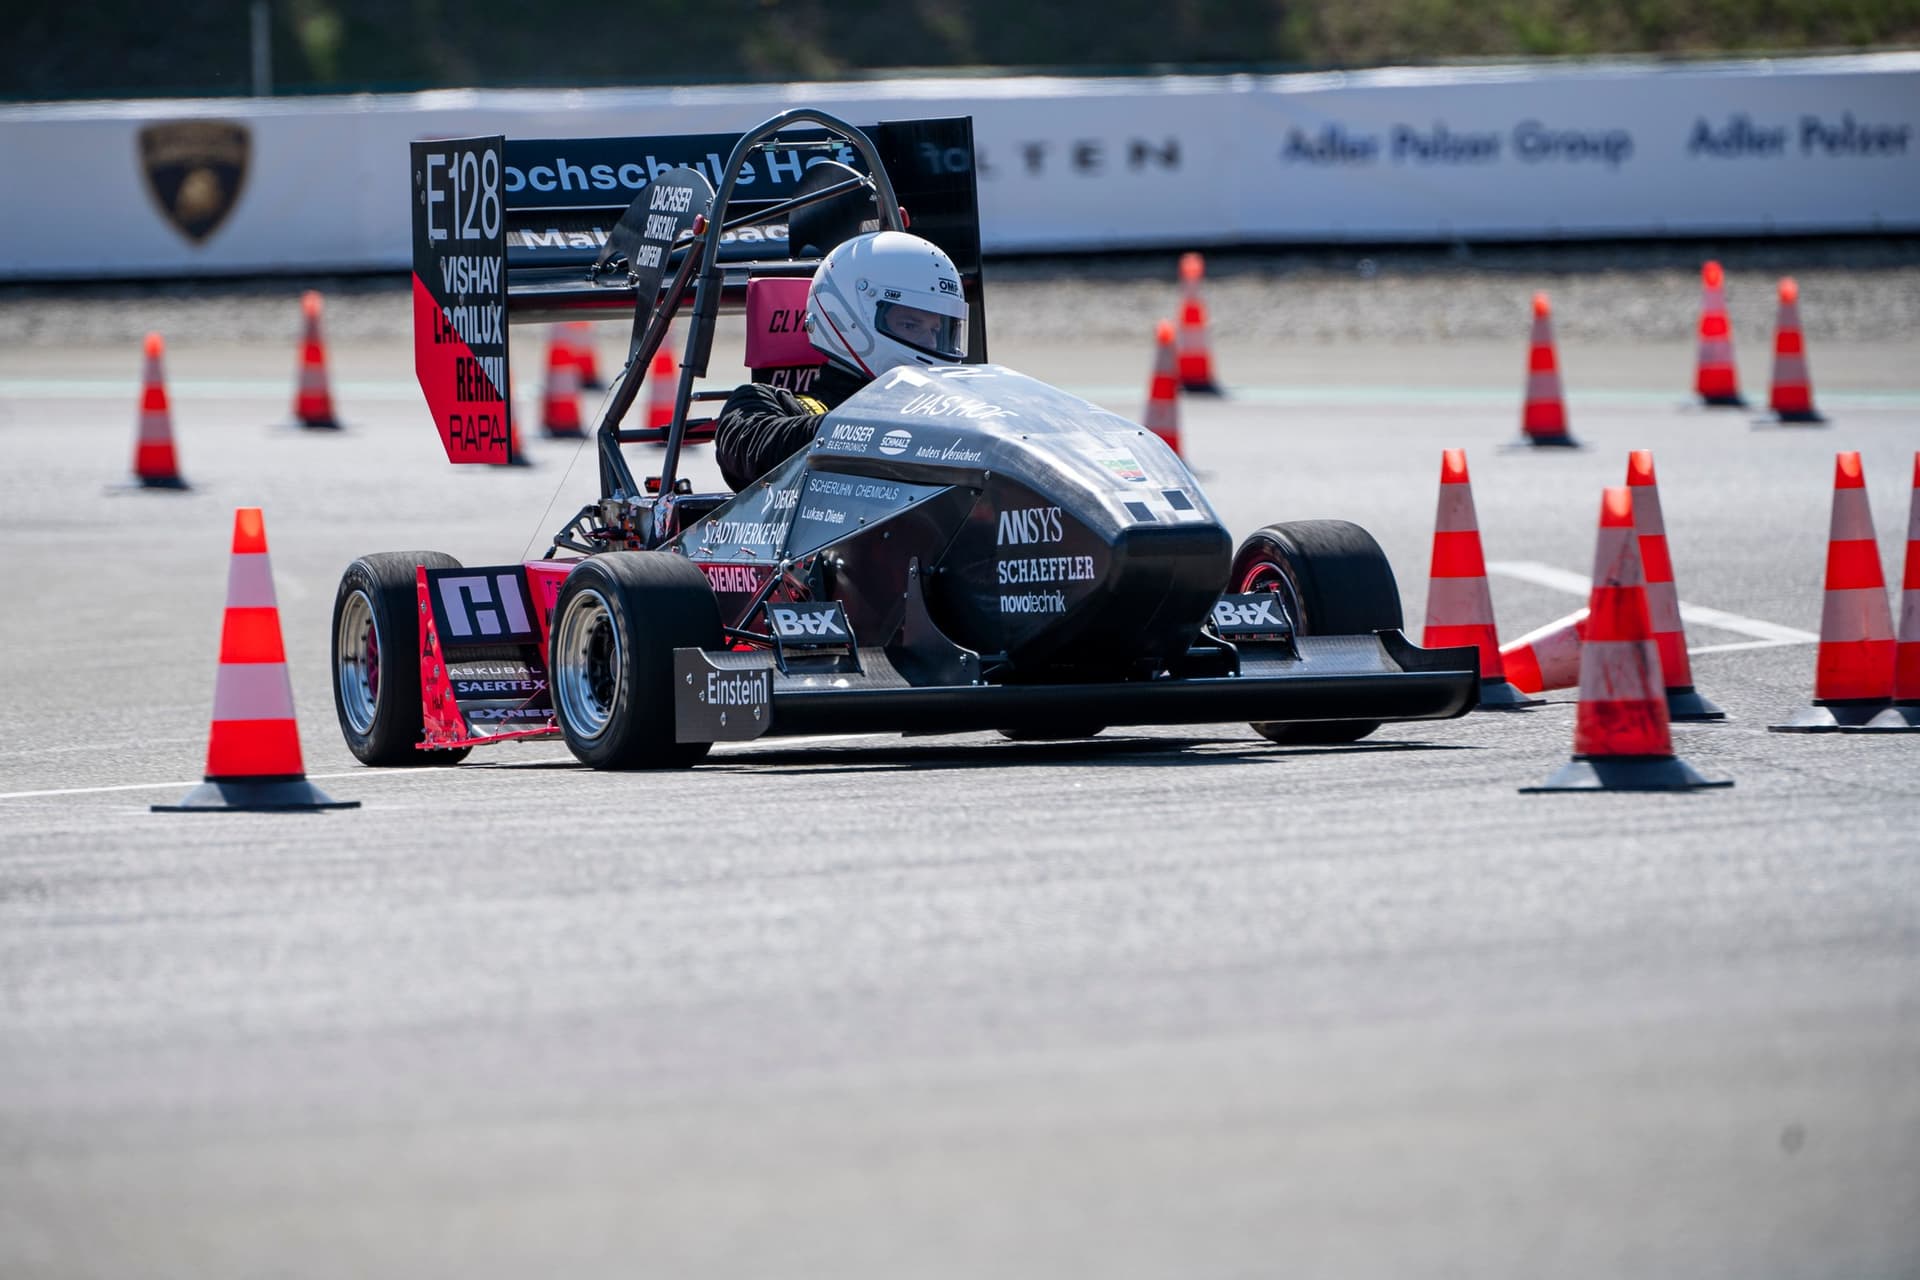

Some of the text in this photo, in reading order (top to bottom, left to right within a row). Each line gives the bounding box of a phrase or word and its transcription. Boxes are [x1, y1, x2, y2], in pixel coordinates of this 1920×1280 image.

[1281, 122, 1379, 165] Adler
[1511, 118, 1634, 171] Group
[975, 138, 1182, 179] LTEN
[427, 149, 500, 240] E128
[649, 185, 693, 213] DACHSER
[443, 256, 501, 294] VISHAY
[939, 280, 959, 293] OMP
[884, 289, 901, 299] OMP
[434, 306, 503, 345] LAMILUX
[769, 309, 808, 333] CLY
[456, 356, 504, 402] REHAU
[450, 414, 507, 451] RAPA
[831, 424, 875, 442] MOUSER
[880, 437, 911, 448] SCHMALZ
[826, 440, 868, 453] ELECTRONICS
[915, 445, 941, 459] Anders
[809, 478, 900, 500] SCHERUHN CHEMICALS
[801, 506, 846, 524] Lukas Dietel
[997, 506, 1063, 546] ANSYS
[702, 521, 772, 545] STADTWERKE
[708, 567, 758, 593] SIEMENS
[998, 556, 1095, 584] SCHAEFFLER
[773, 608, 845, 636] BtX
[1213, 600, 1283, 626] BtX
[450, 665, 542, 676] ASKUBAL
[457, 679, 547, 692] SAERTEX
[707, 671, 767, 705] Einstein1
